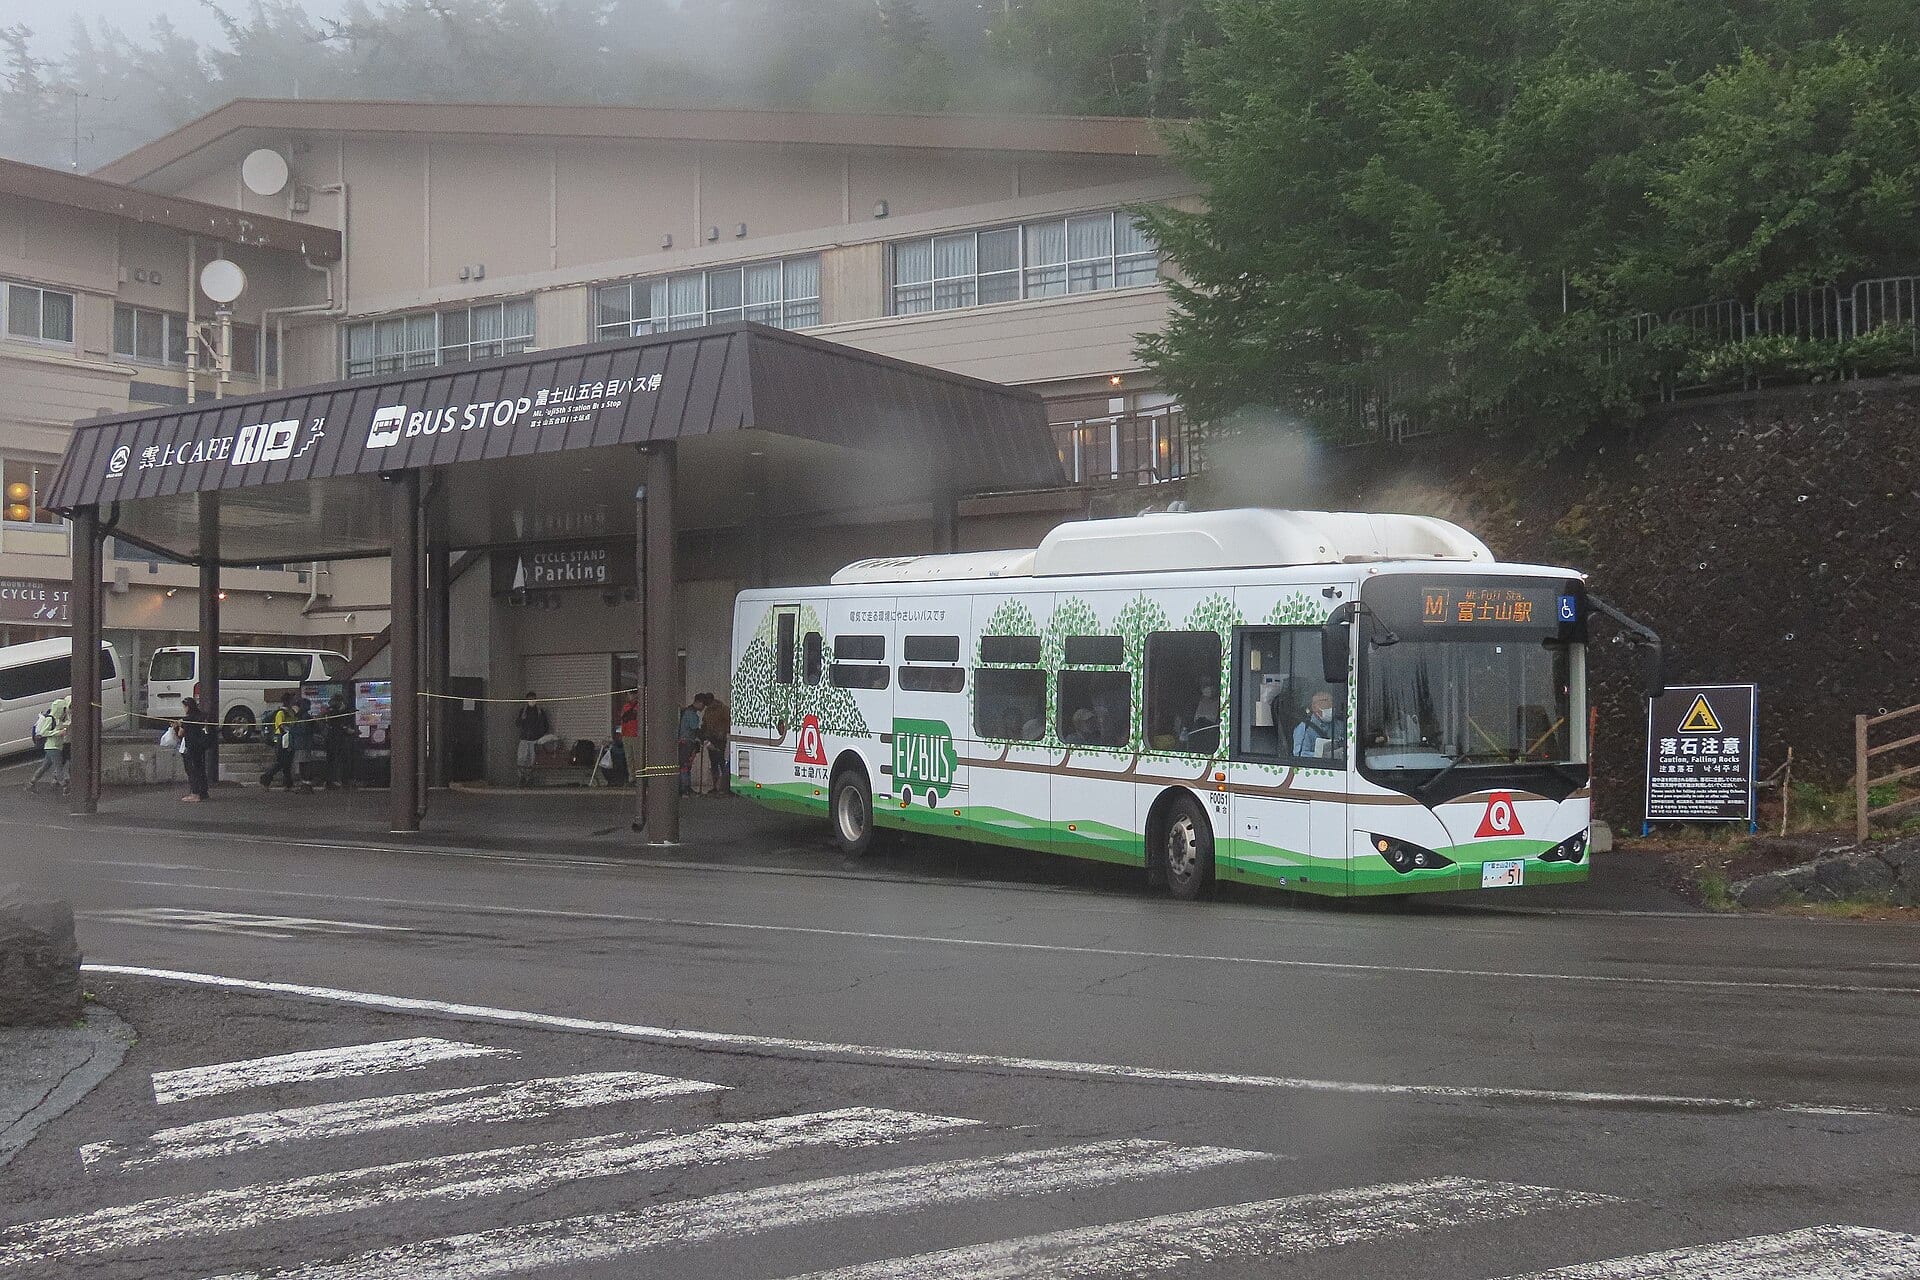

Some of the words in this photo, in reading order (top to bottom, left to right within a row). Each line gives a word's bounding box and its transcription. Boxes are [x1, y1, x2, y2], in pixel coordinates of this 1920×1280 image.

[535, 373, 663, 407] 富士山五合目バス停
[606, 400, 622, 409] Stop
[405, 405, 457, 438] BUS
[460, 396, 533, 431] STOP
[534, 553, 566, 563] CYCLE
[570, 550, 605, 562] STAND
[535, 563, 606, 582] Parking
[1, 589, 46, 601] CYCLE
[1425, 595, 1443, 615] M
[1457, 601, 1532, 622] 富士山駅
[804, 725, 818, 760] Q
[1660, 737, 1740, 755] 落石注意
[897, 733, 950, 782] EV-BUS
[1691, 756, 1717, 764] Falling
[794, 765, 829, 780] 富士急バス
[1210, 792, 1228, 805] F0051
[1489, 800, 1511, 832] Q
[1508, 868, 1520, 884] 51
